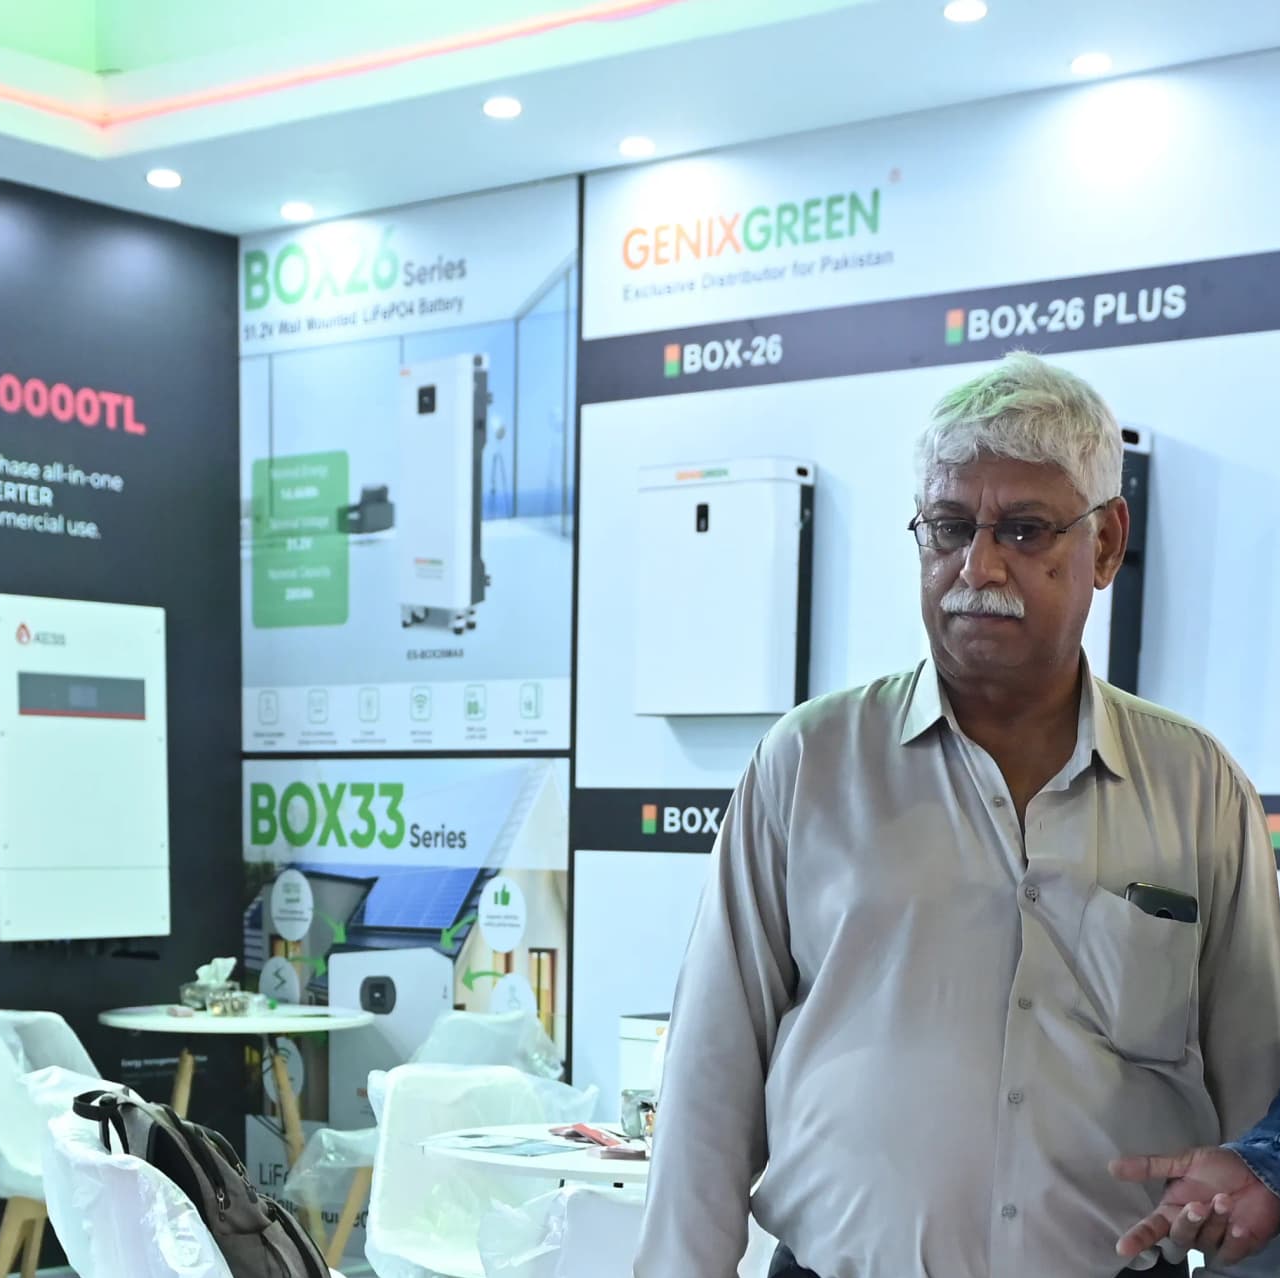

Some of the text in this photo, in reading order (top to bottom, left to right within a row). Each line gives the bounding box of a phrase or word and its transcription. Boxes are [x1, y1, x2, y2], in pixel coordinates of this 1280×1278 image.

[622, 187, 881, 271] GENIXGREEN
[403, 255, 467, 288] Series
[623, 250, 895, 302] Exclusive Distributor for Pakistan
[967, 285, 1187, 342] BOX-26 PLUS
[681, 334, 783, 376] BOX-26
[43, 461, 125, 493] all-in-one
[249, 781, 467, 850] BOX33 Series
